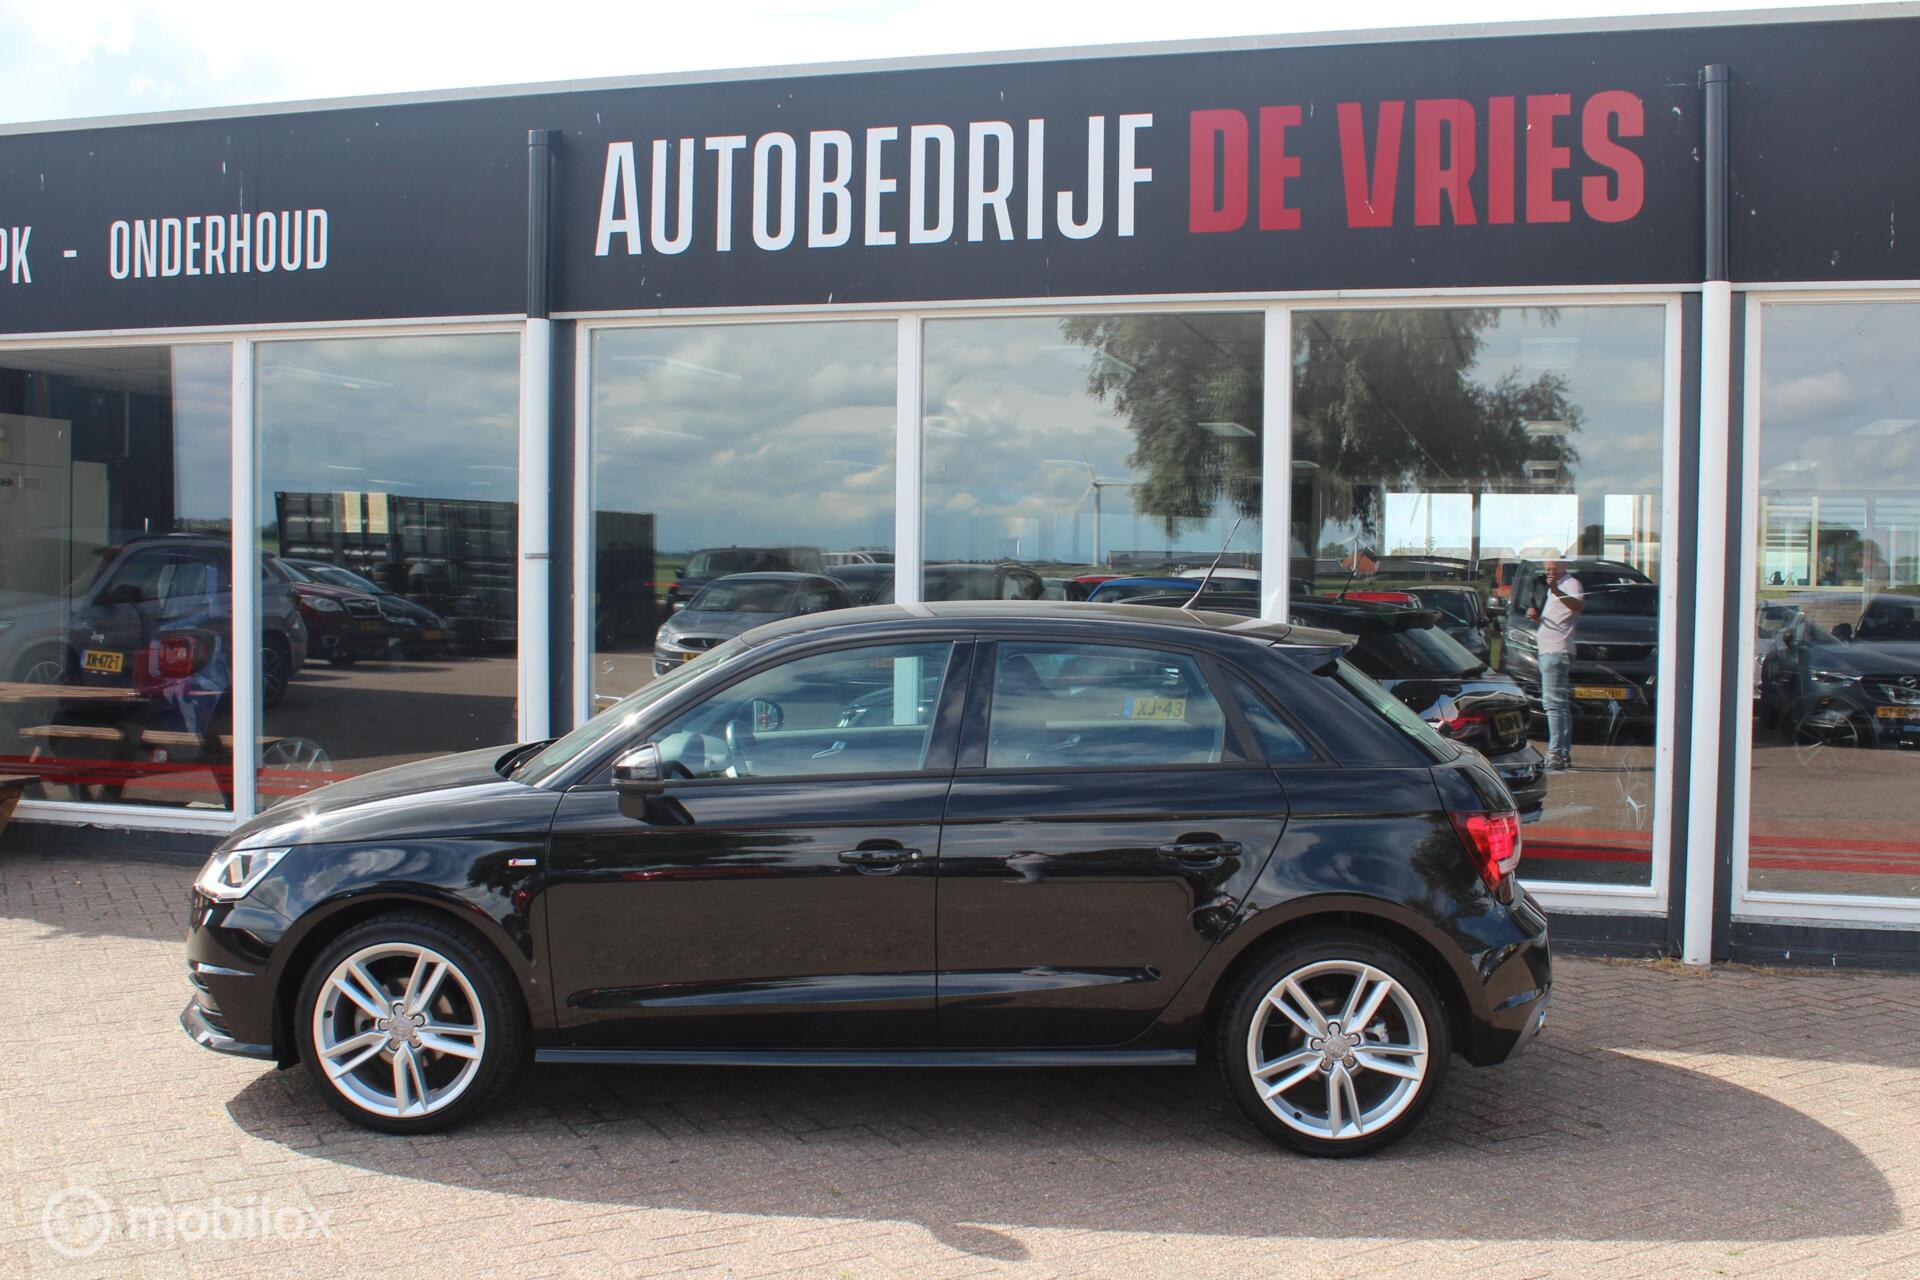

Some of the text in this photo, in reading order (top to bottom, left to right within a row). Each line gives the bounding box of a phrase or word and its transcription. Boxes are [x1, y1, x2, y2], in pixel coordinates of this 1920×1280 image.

[595, 90, 1645, 257] AUTOBEDRIJF DE VRIES
[108, 208, 329, 281] ONDERHOUD
